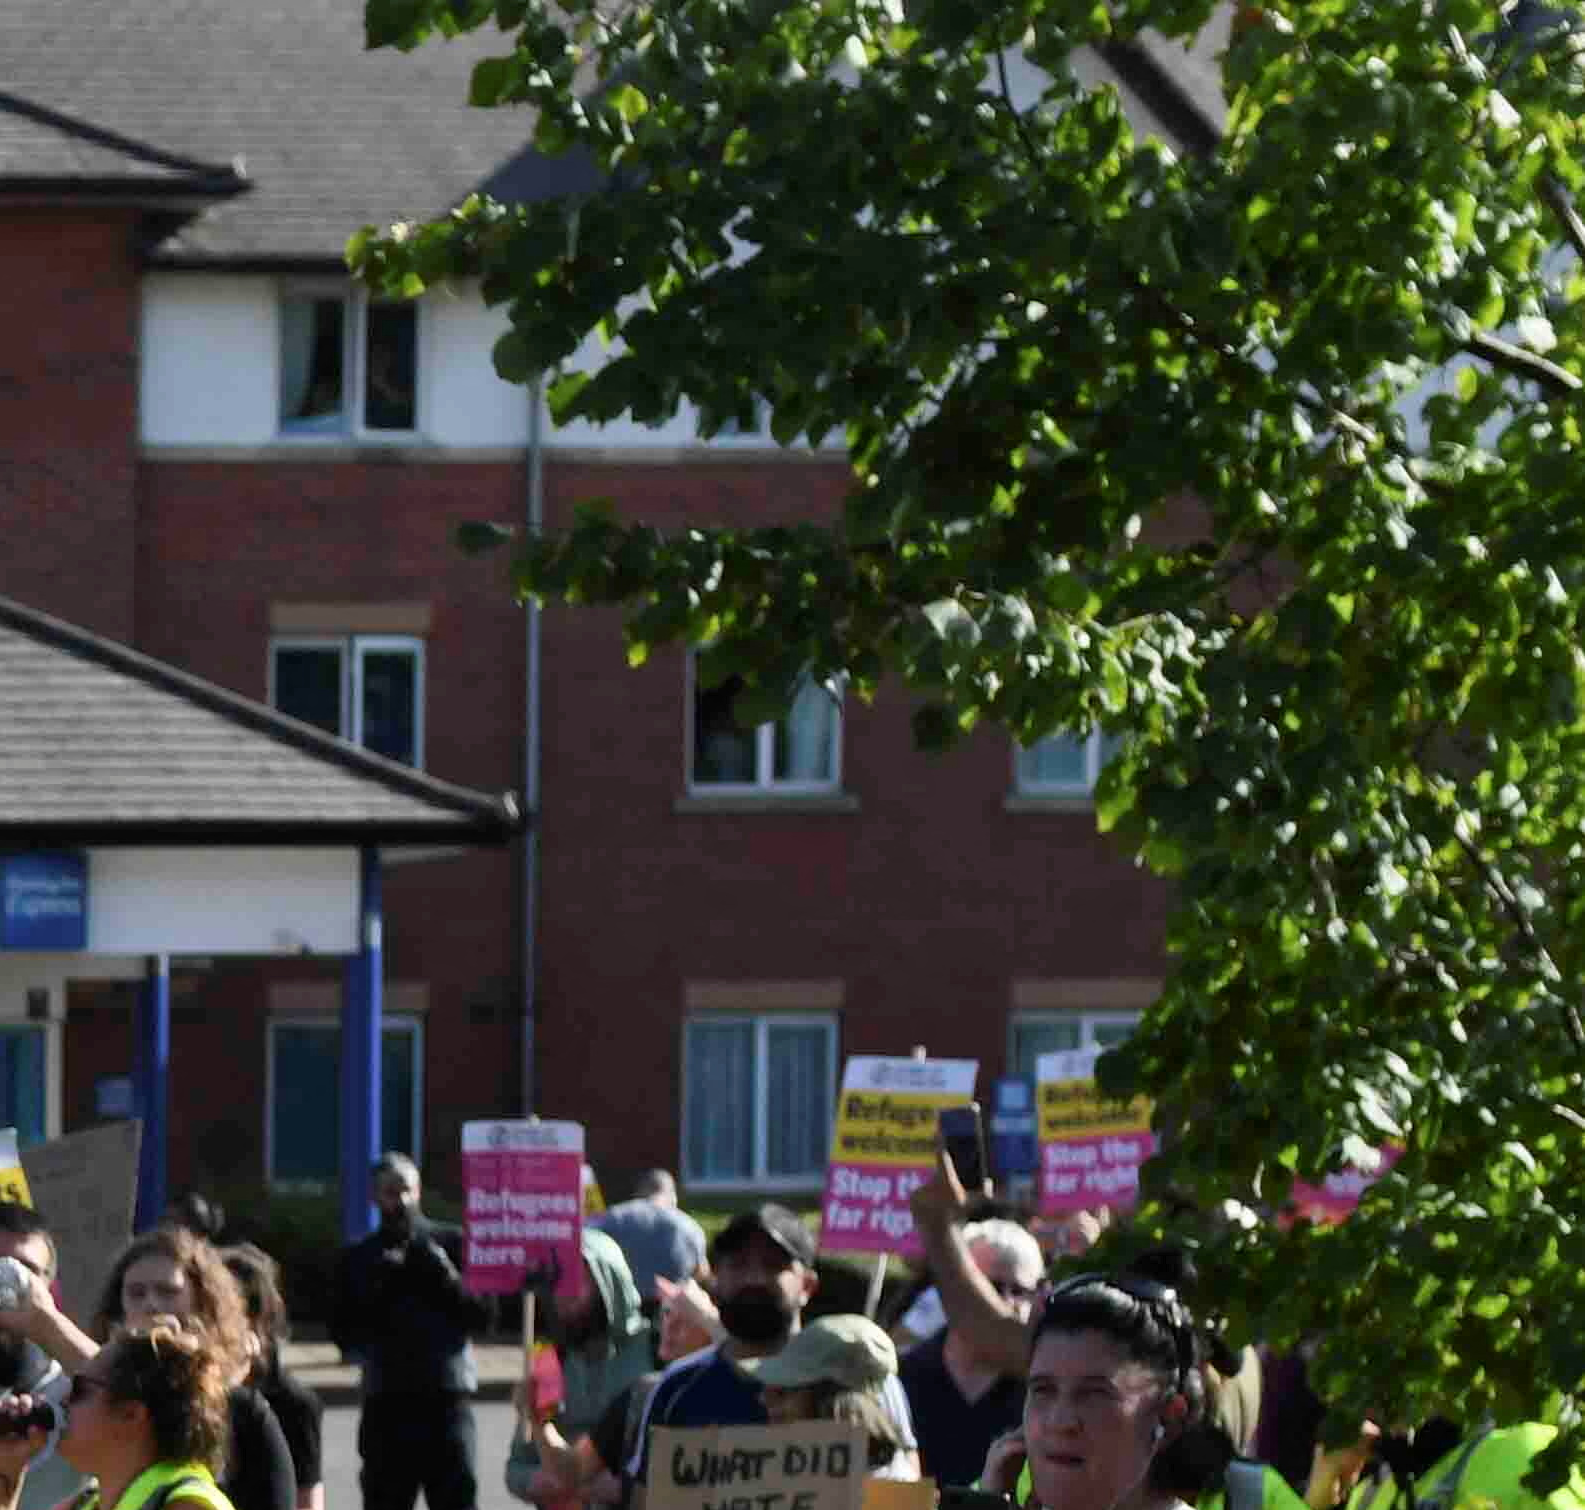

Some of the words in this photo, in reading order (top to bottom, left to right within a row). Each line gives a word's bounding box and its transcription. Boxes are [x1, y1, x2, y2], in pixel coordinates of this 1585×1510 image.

[847, 1093, 938, 1128] Refuge
[842, 1128, 940, 1154] welcom
[830, 1168, 892, 1204] Stop
[827, 1200, 865, 1231] far
[671, 1445, 775, 1487] WHAT
[783, 1441, 852, 1478] DID
